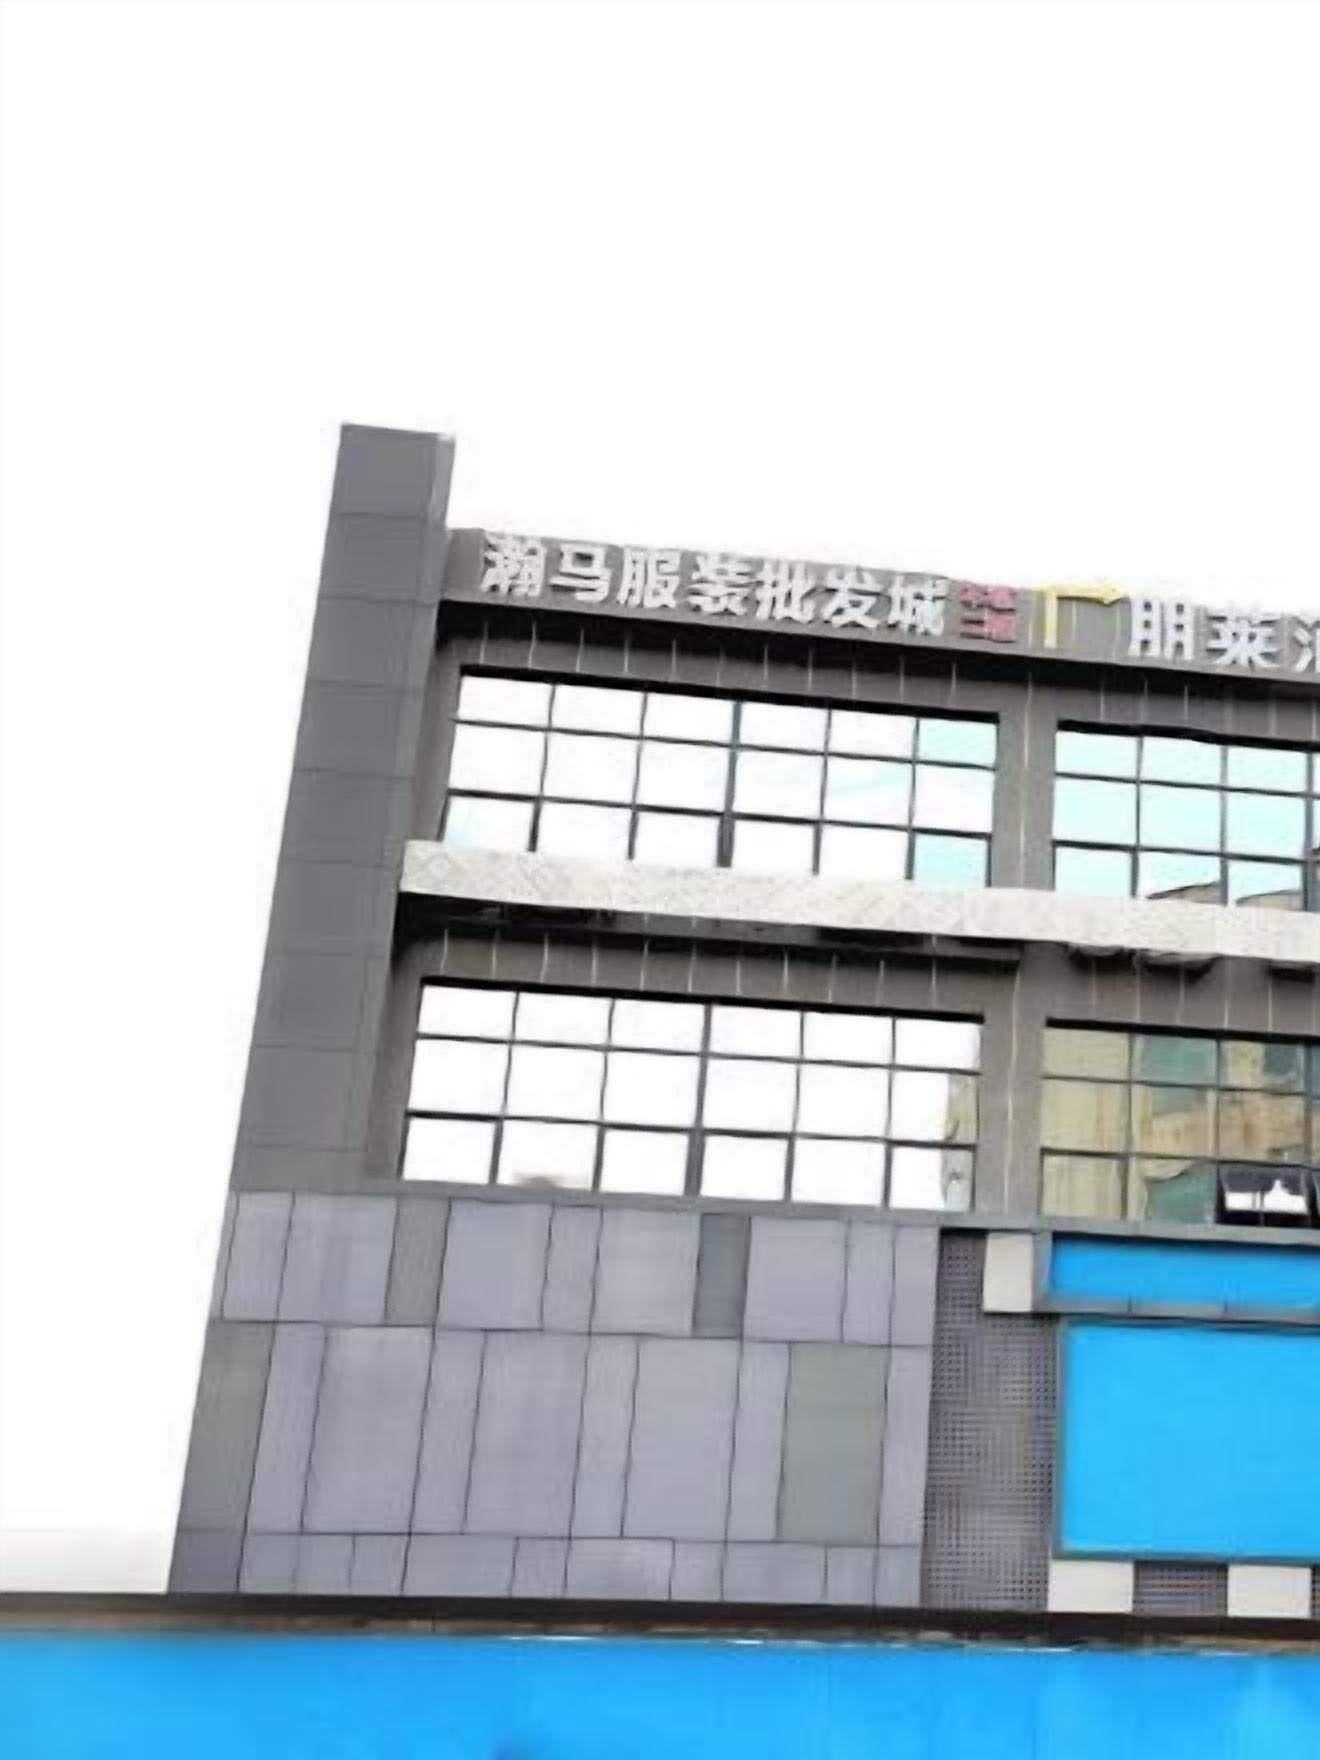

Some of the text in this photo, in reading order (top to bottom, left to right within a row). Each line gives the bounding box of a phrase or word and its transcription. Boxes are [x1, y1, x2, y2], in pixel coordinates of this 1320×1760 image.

[480, 530, 949, 636] 瀚马服装批发城
